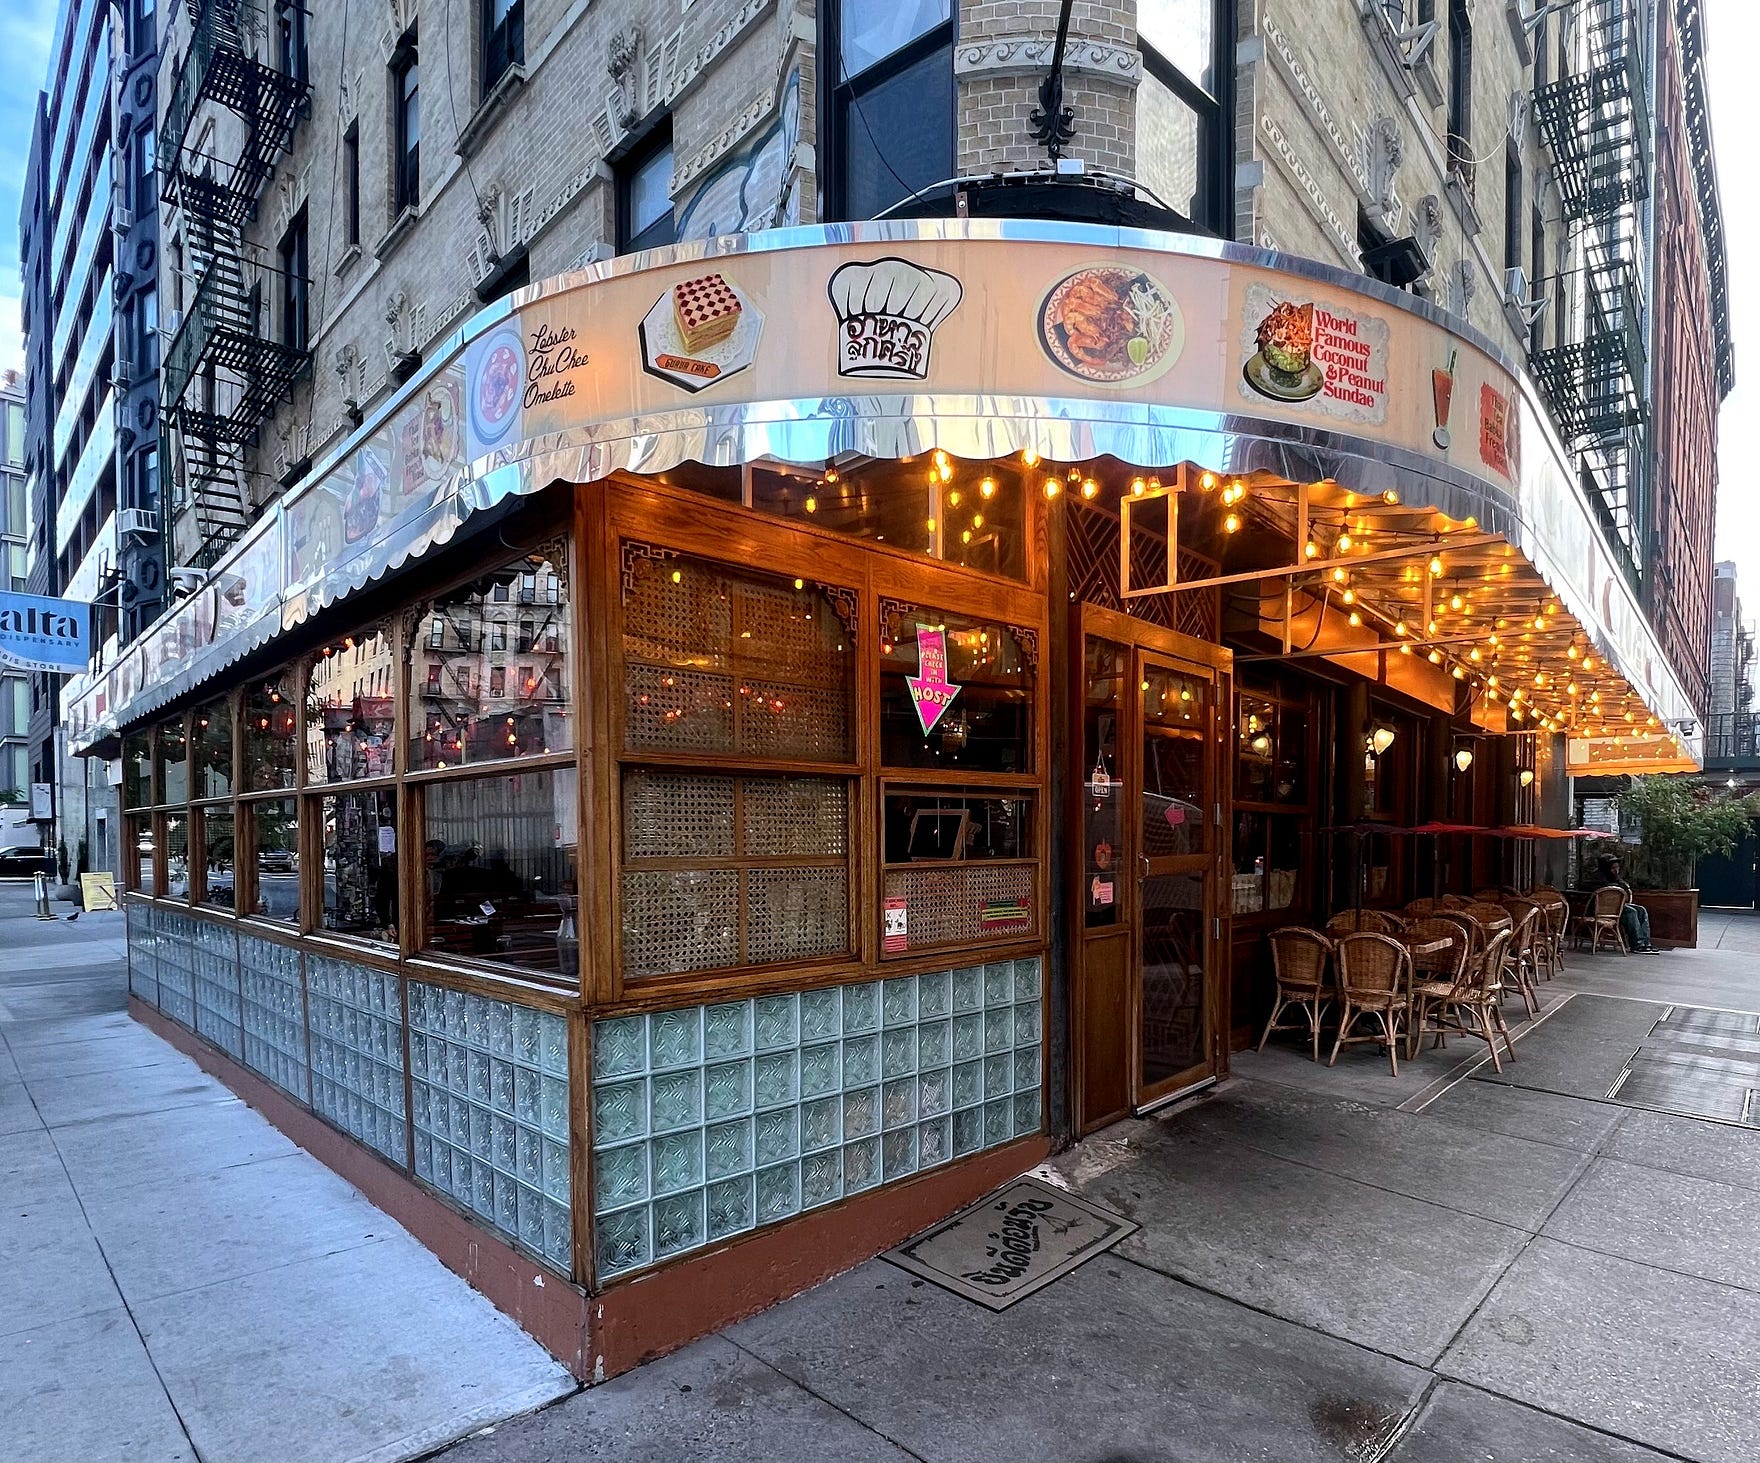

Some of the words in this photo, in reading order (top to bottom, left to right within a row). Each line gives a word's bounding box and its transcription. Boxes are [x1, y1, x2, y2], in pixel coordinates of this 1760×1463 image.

[1315, 310, 1357, 336] World
[528, 324, 577, 354] Lobster
[1315, 327, 1371, 357] Famous
[691, 363, 711, 374] CAKE
[1313, 344, 1368, 372] Coconut
[1325, 364, 1338, 381] &
[1338, 366, 1384, 394] Peanut
[523, 380, 576, 409] Omelette
[1323, 380, 1375, 408] Sundae
[25, 661, 61, 671] STORE
[921, 651, 944, 661] PLEASE
[924, 661, 943, 669] CHECK
[925, 676, 943, 684] WITH
[914, 686, 951, 706] HOST
[1094, 785, 1108, 794] OPEN
